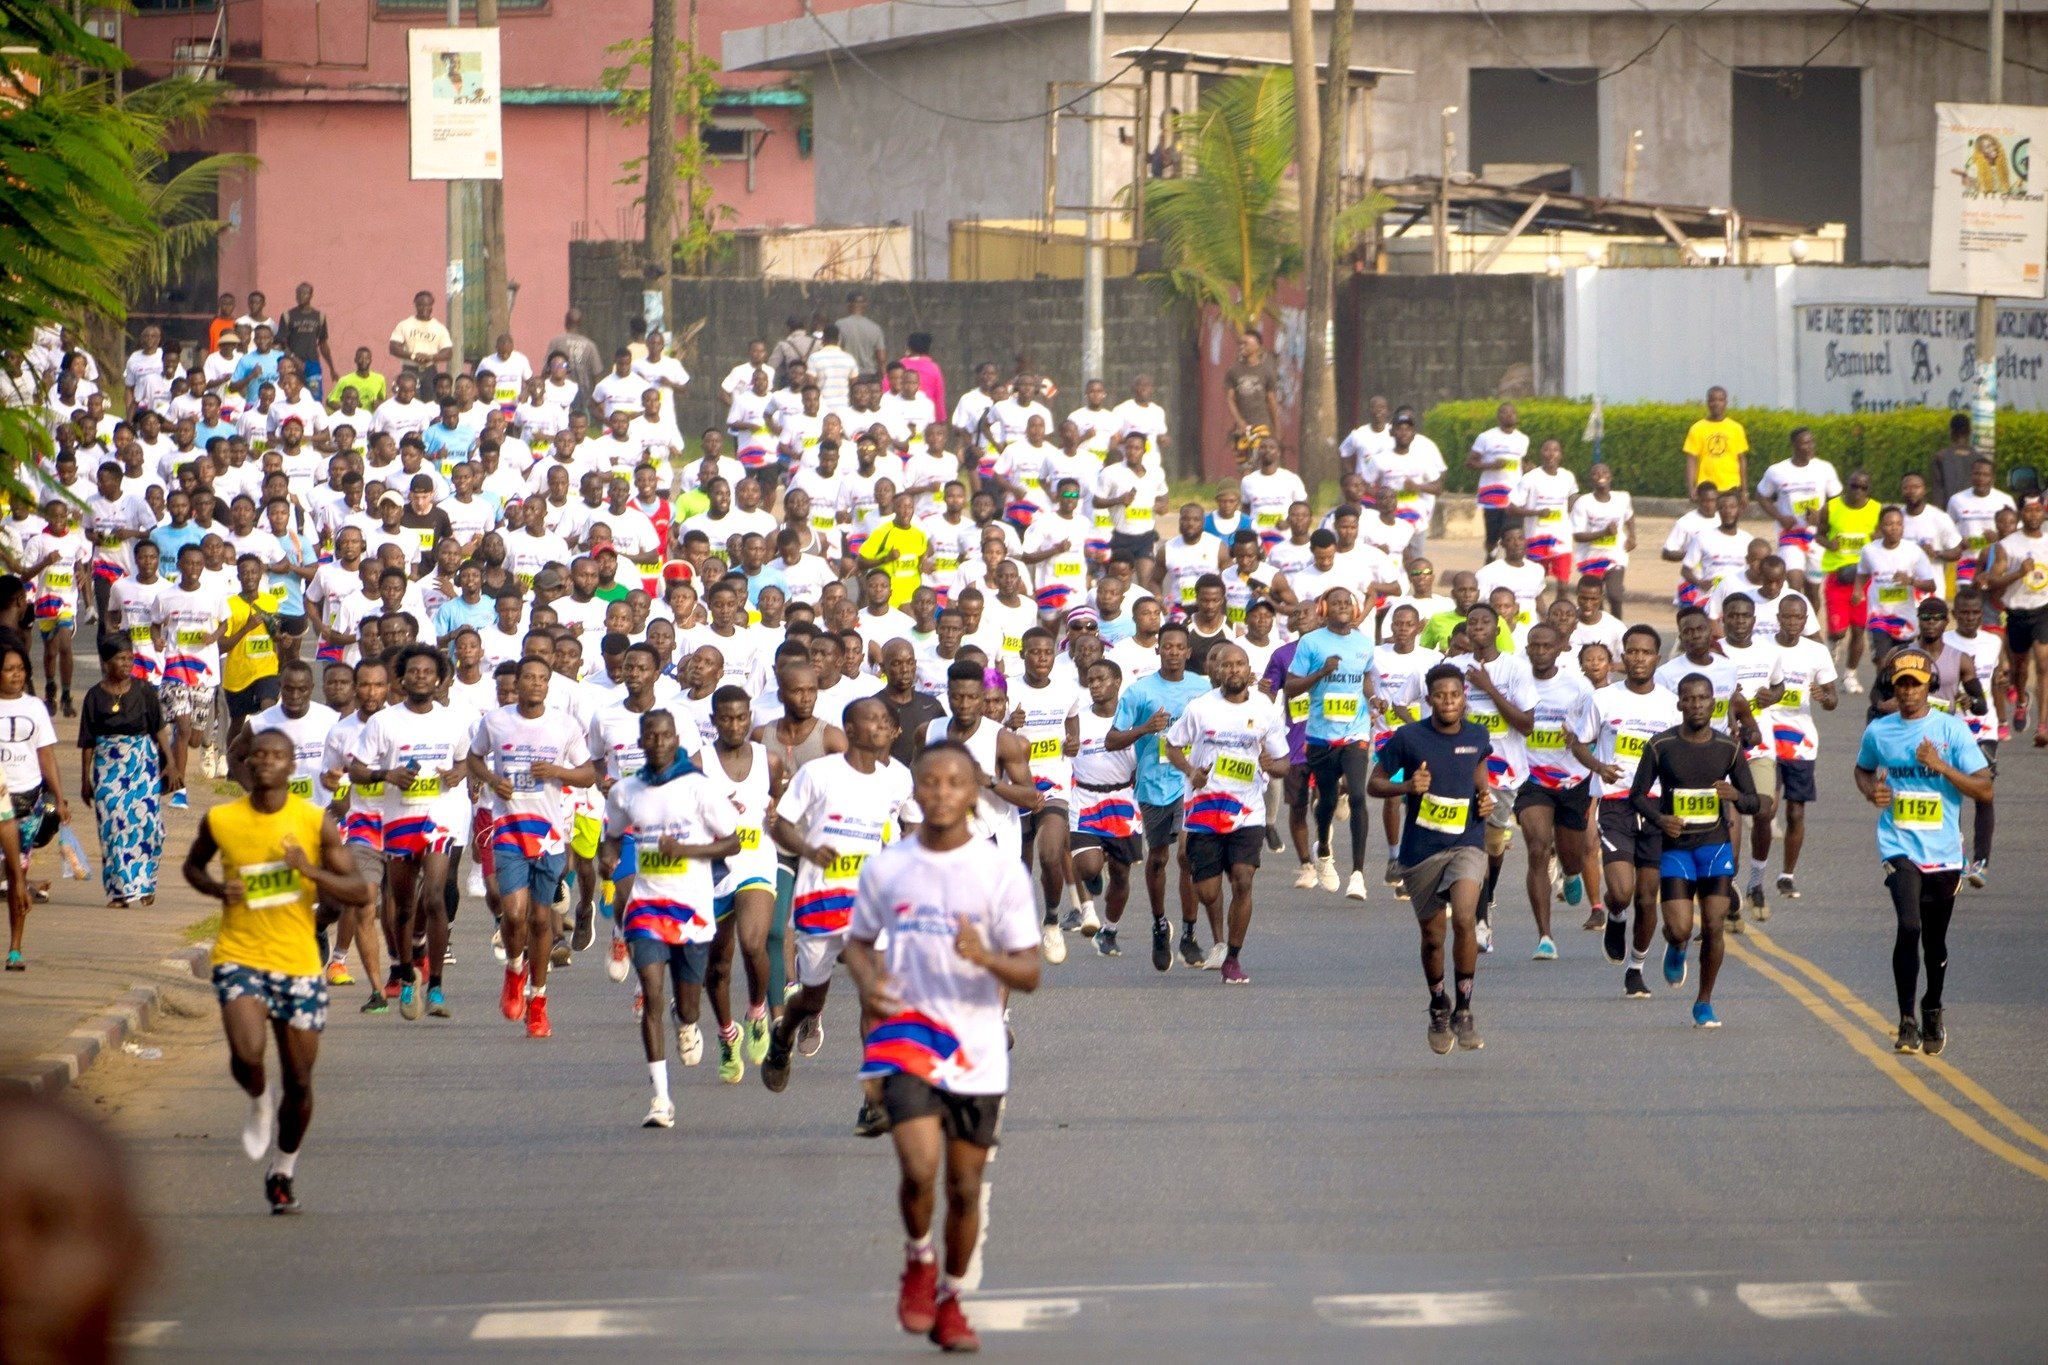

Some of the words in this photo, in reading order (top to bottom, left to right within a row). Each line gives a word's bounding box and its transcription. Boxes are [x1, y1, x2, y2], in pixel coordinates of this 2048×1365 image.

[1806, 308, 1821, 331] WE
[1825, 308, 1843, 334] ARE
[1847, 308, 1873, 335] HERE
[1877, 309, 1891, 335] TO
[1894, 309, 1941, 337] CONSOLE
[1945, 310, 1977, 338] FAMIL
[1825, 340, 1890, 382] Samuel
[1911, 339, 1940, 384] A.
[252, 639, 271, 652] 721
[1032, 739, 1057, 754] 795
[1219, 758, 1253, 778] 1260
[1428, 803, 1458, 820] 735
[1678, 796, 1715, 811] 1915
[1897, 799, 1938, 816] 1157
[831, 854, 868, 872] 167
[246, 869, 295, 891] 2017
